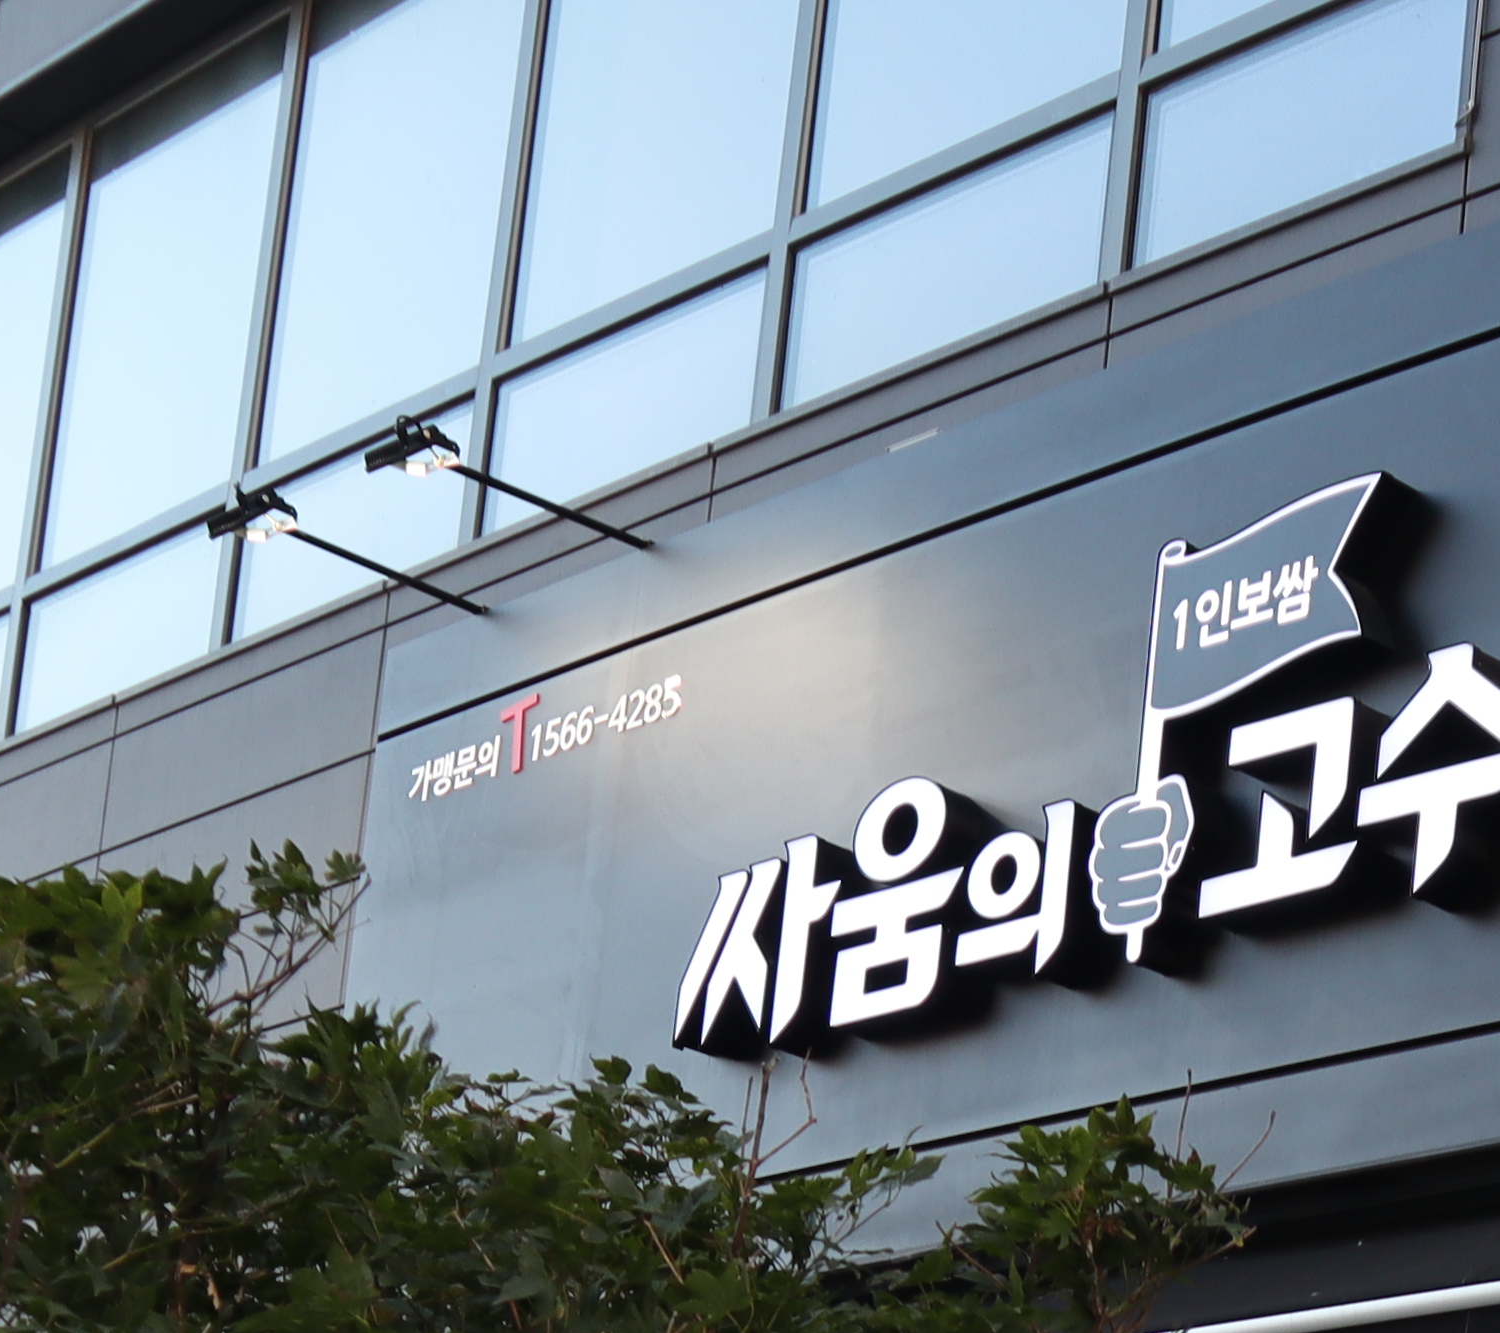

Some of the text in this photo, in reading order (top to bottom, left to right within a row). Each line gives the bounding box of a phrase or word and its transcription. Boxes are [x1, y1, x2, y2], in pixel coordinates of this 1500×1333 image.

[1171, 553, 1320, 651] 1인보쌈
[407, 734, 500, 802] 가맹문의
[530, 673, 684, 763] 1566-4285
[673, 776, 1076, 1048] 싸움의
